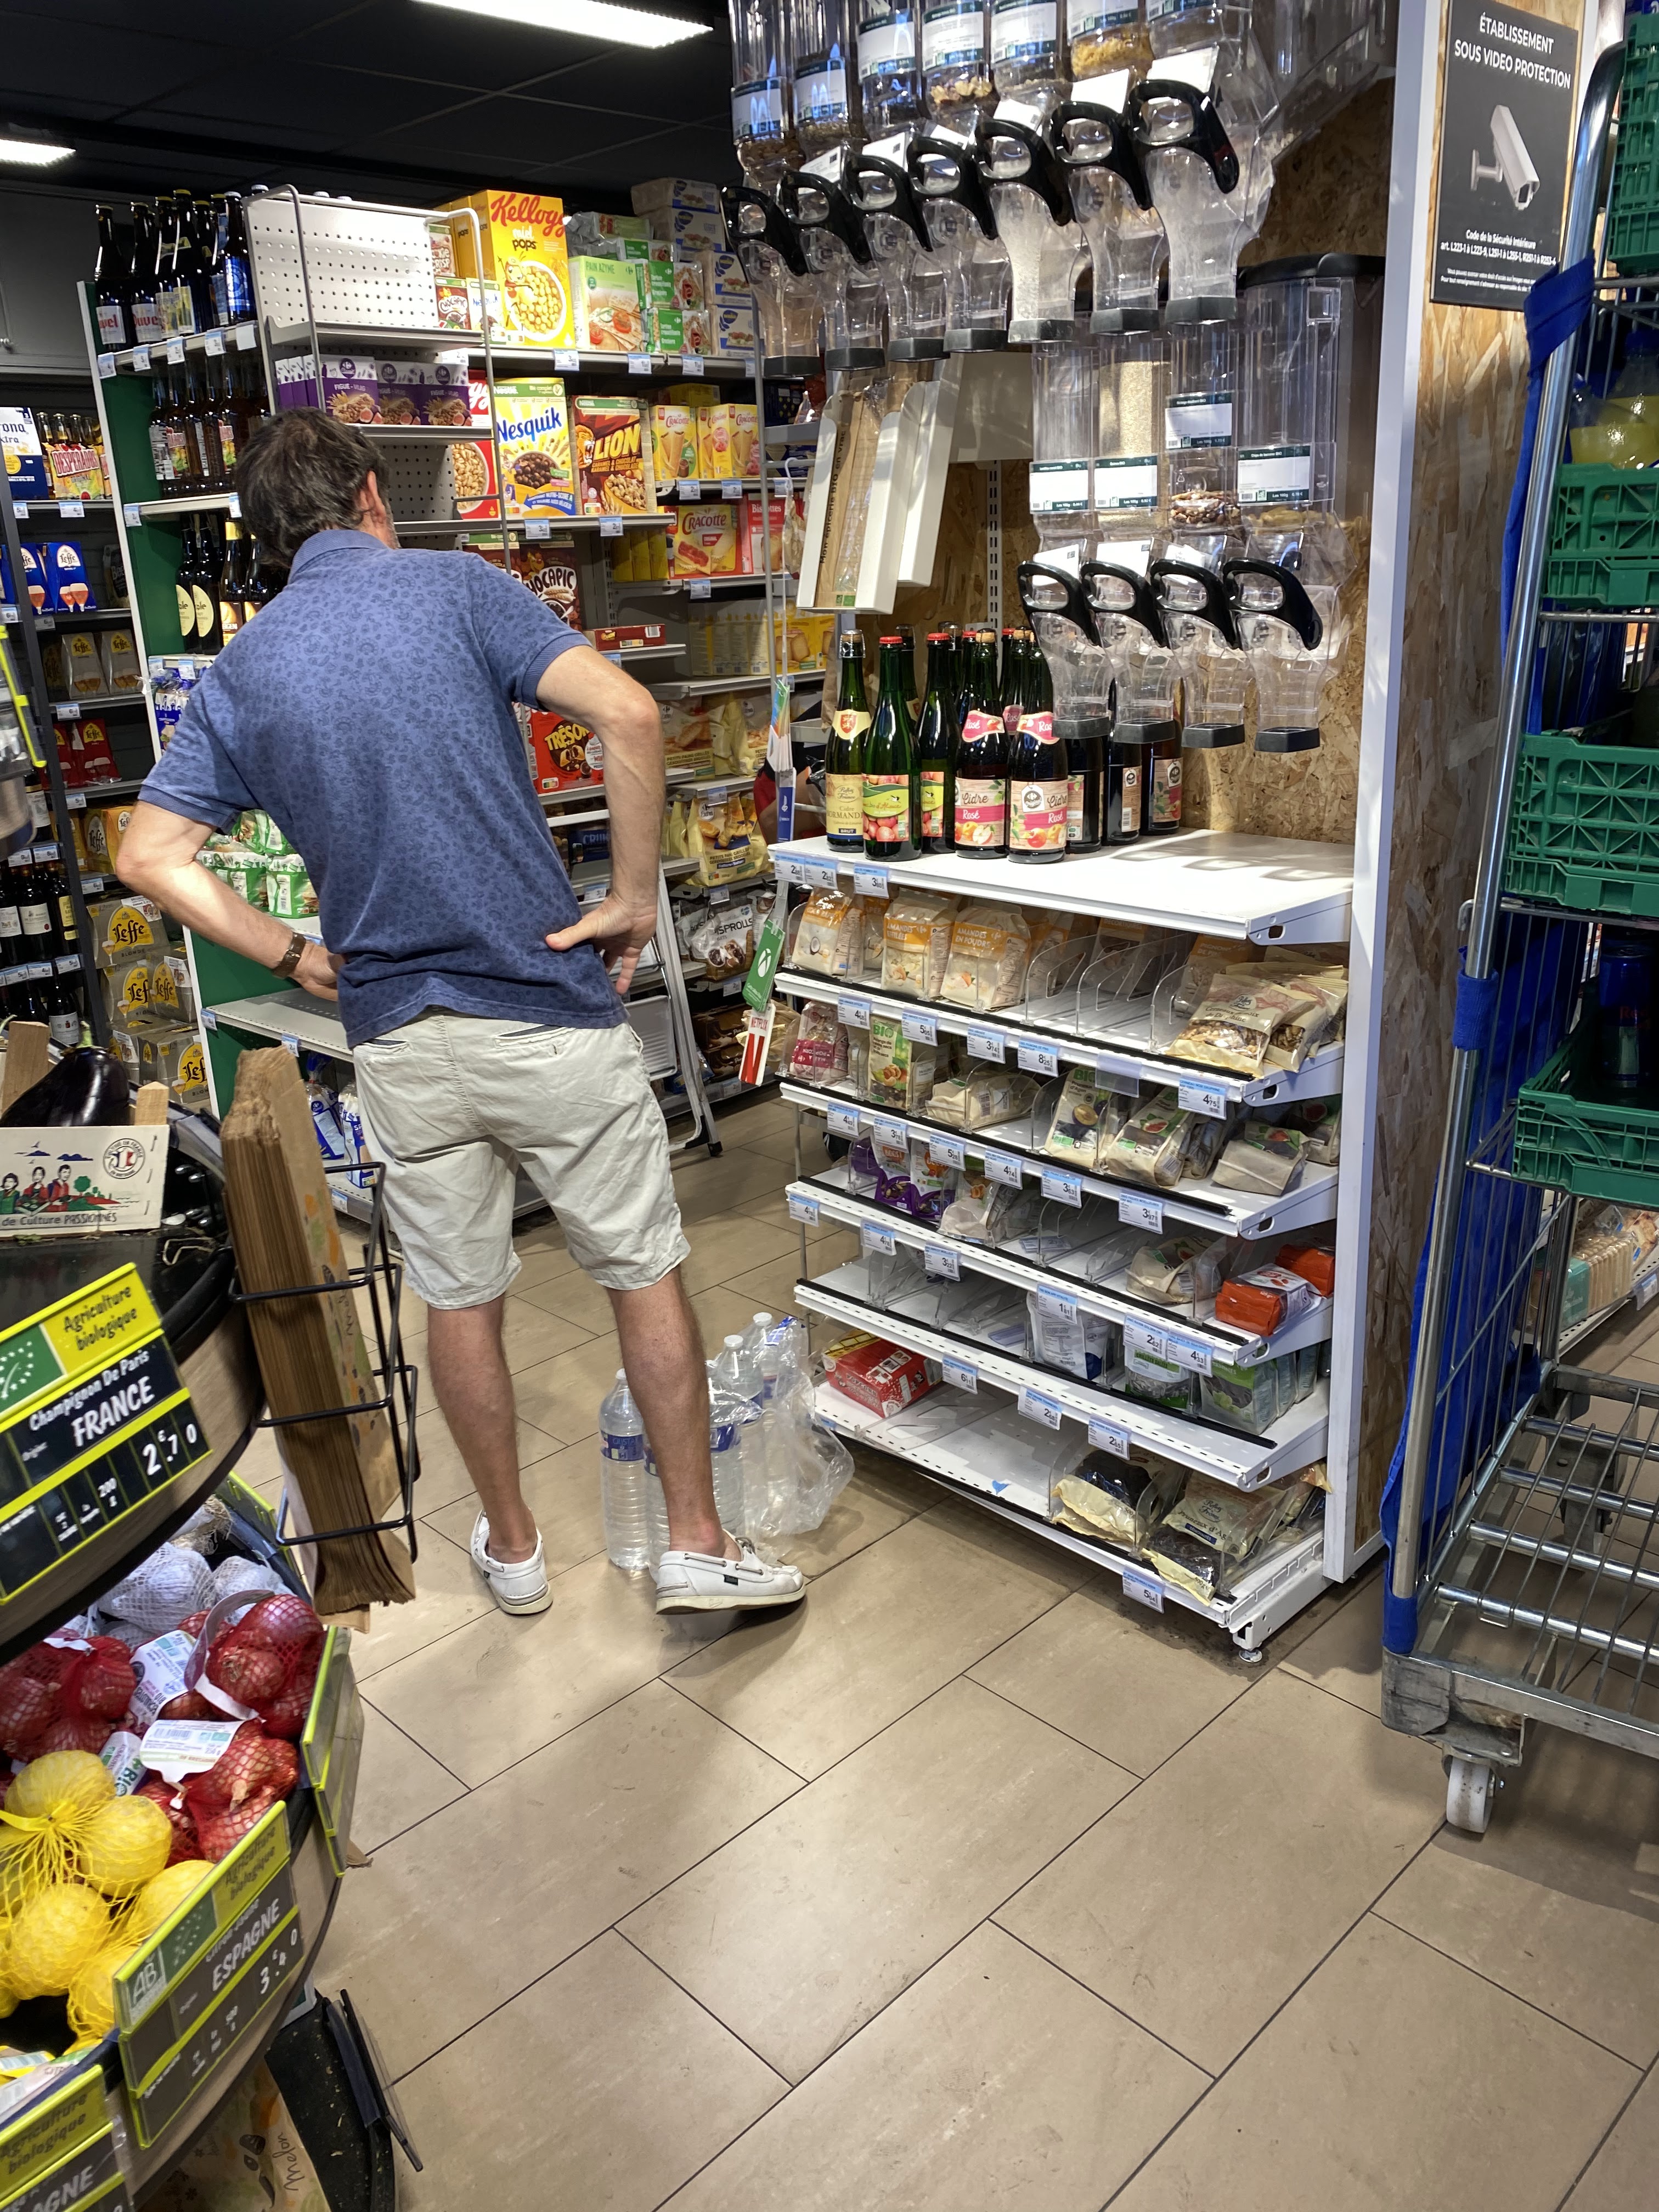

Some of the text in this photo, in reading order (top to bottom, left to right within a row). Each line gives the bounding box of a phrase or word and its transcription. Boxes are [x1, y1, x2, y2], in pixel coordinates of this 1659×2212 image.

[1479, 12, 1554, 54] ÉTABLISSEMENT
[1454, 39, 1571, 89] SOUS VIDEO PROTECTION
[1466, 229, 1480, 241] Code
[1480, 231, 1487, 242] de
[1487, 232, 1492, 242] la
[1493, 234, 1513, 246] Sécurité
[512, 239, 537, 252] pops
[1441, 242, 1451, 251] art.
[585, 261, 614, 274] PAIN AZYME
[496, 407, 562, 443] Nesquik
[752, 503, 781, 513] Bisottes
[820, 545, 828, 564] Mon
[835, 456, 841, 470] en
[59, 552, 76, 566] Leffe
[526, 568, 575, 594] HOCAPIC
[74, 640, 90, 654] Leffe
[112, 637, 129, 650] Leffe
[1039, 720, 1053, 732] Ros
[86, 728, 101, 740] Leffe
[962, 793, 989, 804] Cidre
[963, 810, 980, 820] Rosé
[1048, 811, 1063, 824] Rosé
[583, 833, 610, 845] CRUN
[112, 920, 145, 945] Leffe
[715, 918, 753, 935] ISPROLLS
[888, 923, 912, 933] AMANDES
[957, 928, 987, 939] AMANDES
[964, 937, 991, 949] POUDRE
[121, 948, 146, 957] BLONDE
[127, 978, 149, 1003] Lef
[751, 1018, 768, 1031] NETFLIX
[873, 1024, 894, 1039] BIO
[1038, 1054, 1050, 1065] 8€25
[183, 1057, 207, 1083] Lef
[1073, 1069, 1095, 1083] BIO
[1203, 1094, 1217, 1108] 4€75
[2, 1217, 16, 1226] de
[20, 1214, 61, 1225] Culture
[63, 1285, 132, 1333] Agriculture
[76, 1308, 138, 1352] biologique
[29, 1349, 150, 1431] Champignon De Paris
[71, 1376, 155, 1447] FRANCE
[1177, 1509, 1210, 1531] Pruneaux
[1210, 1526, 1228, 1541] d'Ag
[211, 1898, 280, 1992] ESPAGNE
[132, 1962, 156, 2002] AB
[8, 2113, 86, 2175] biologique
[272, 2131, 306, 2192] Melon
